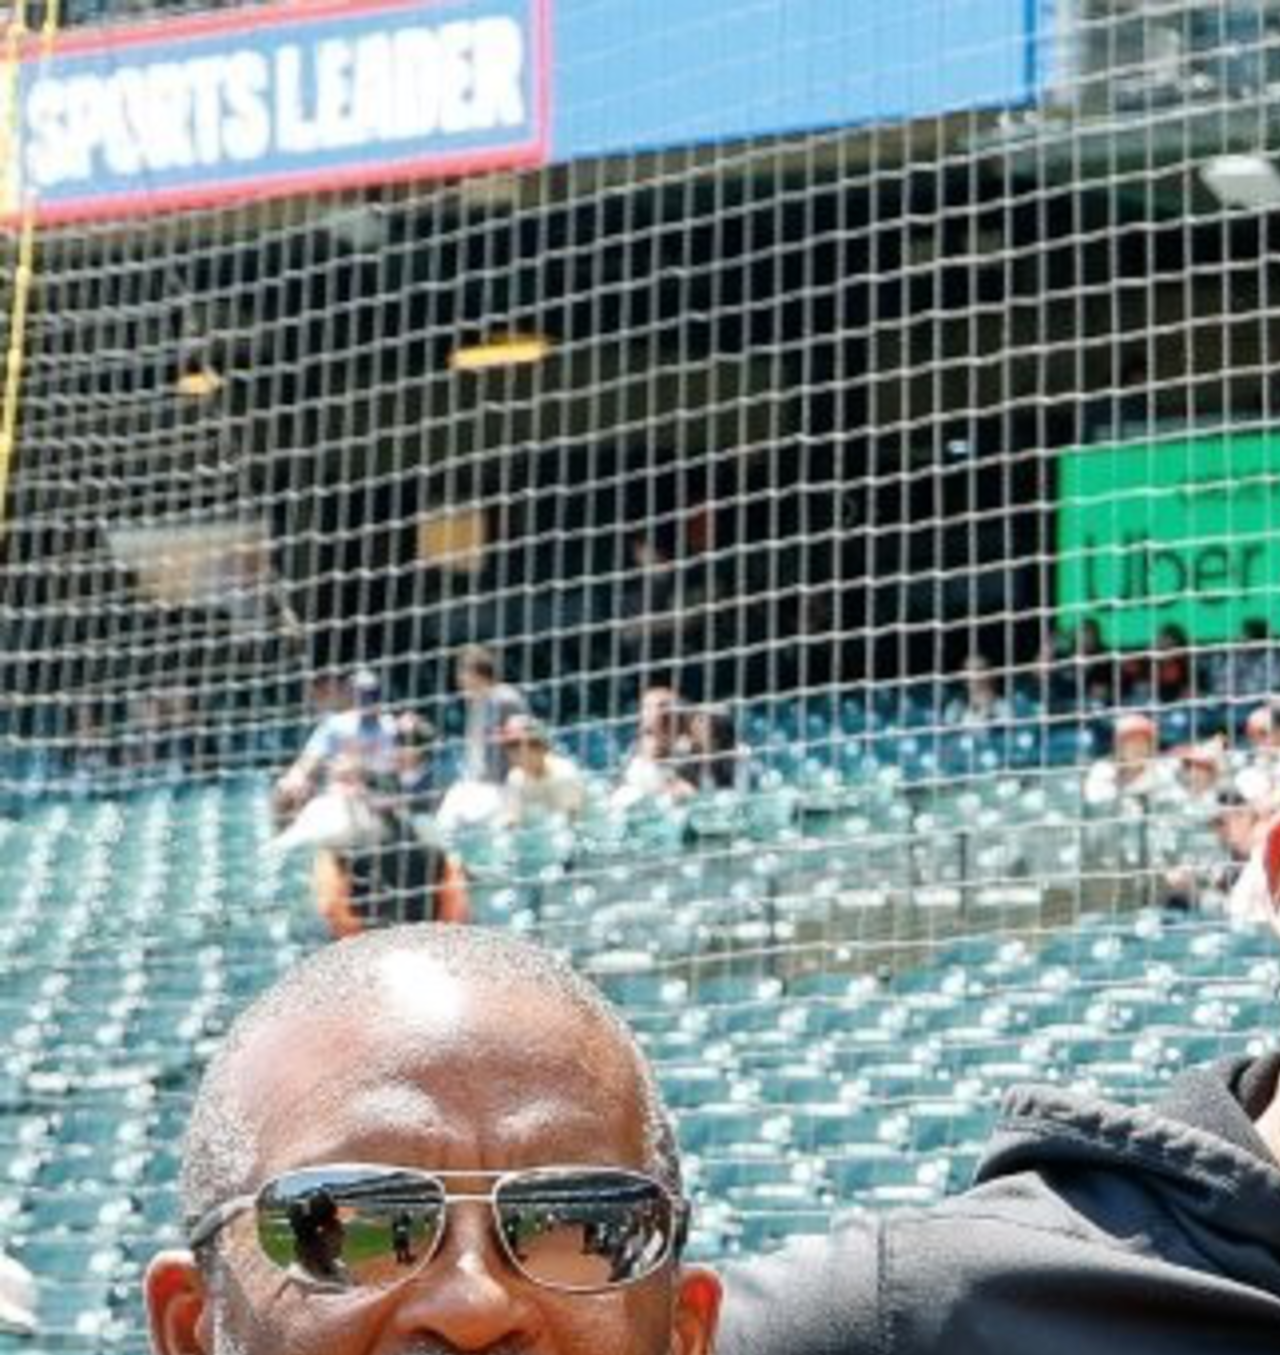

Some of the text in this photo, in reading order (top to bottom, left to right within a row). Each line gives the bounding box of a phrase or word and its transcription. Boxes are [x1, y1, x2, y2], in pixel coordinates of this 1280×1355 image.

[26, 15, 524, 186] SPORTS LEADER
[1084, 530, 1266, 612] Uber
